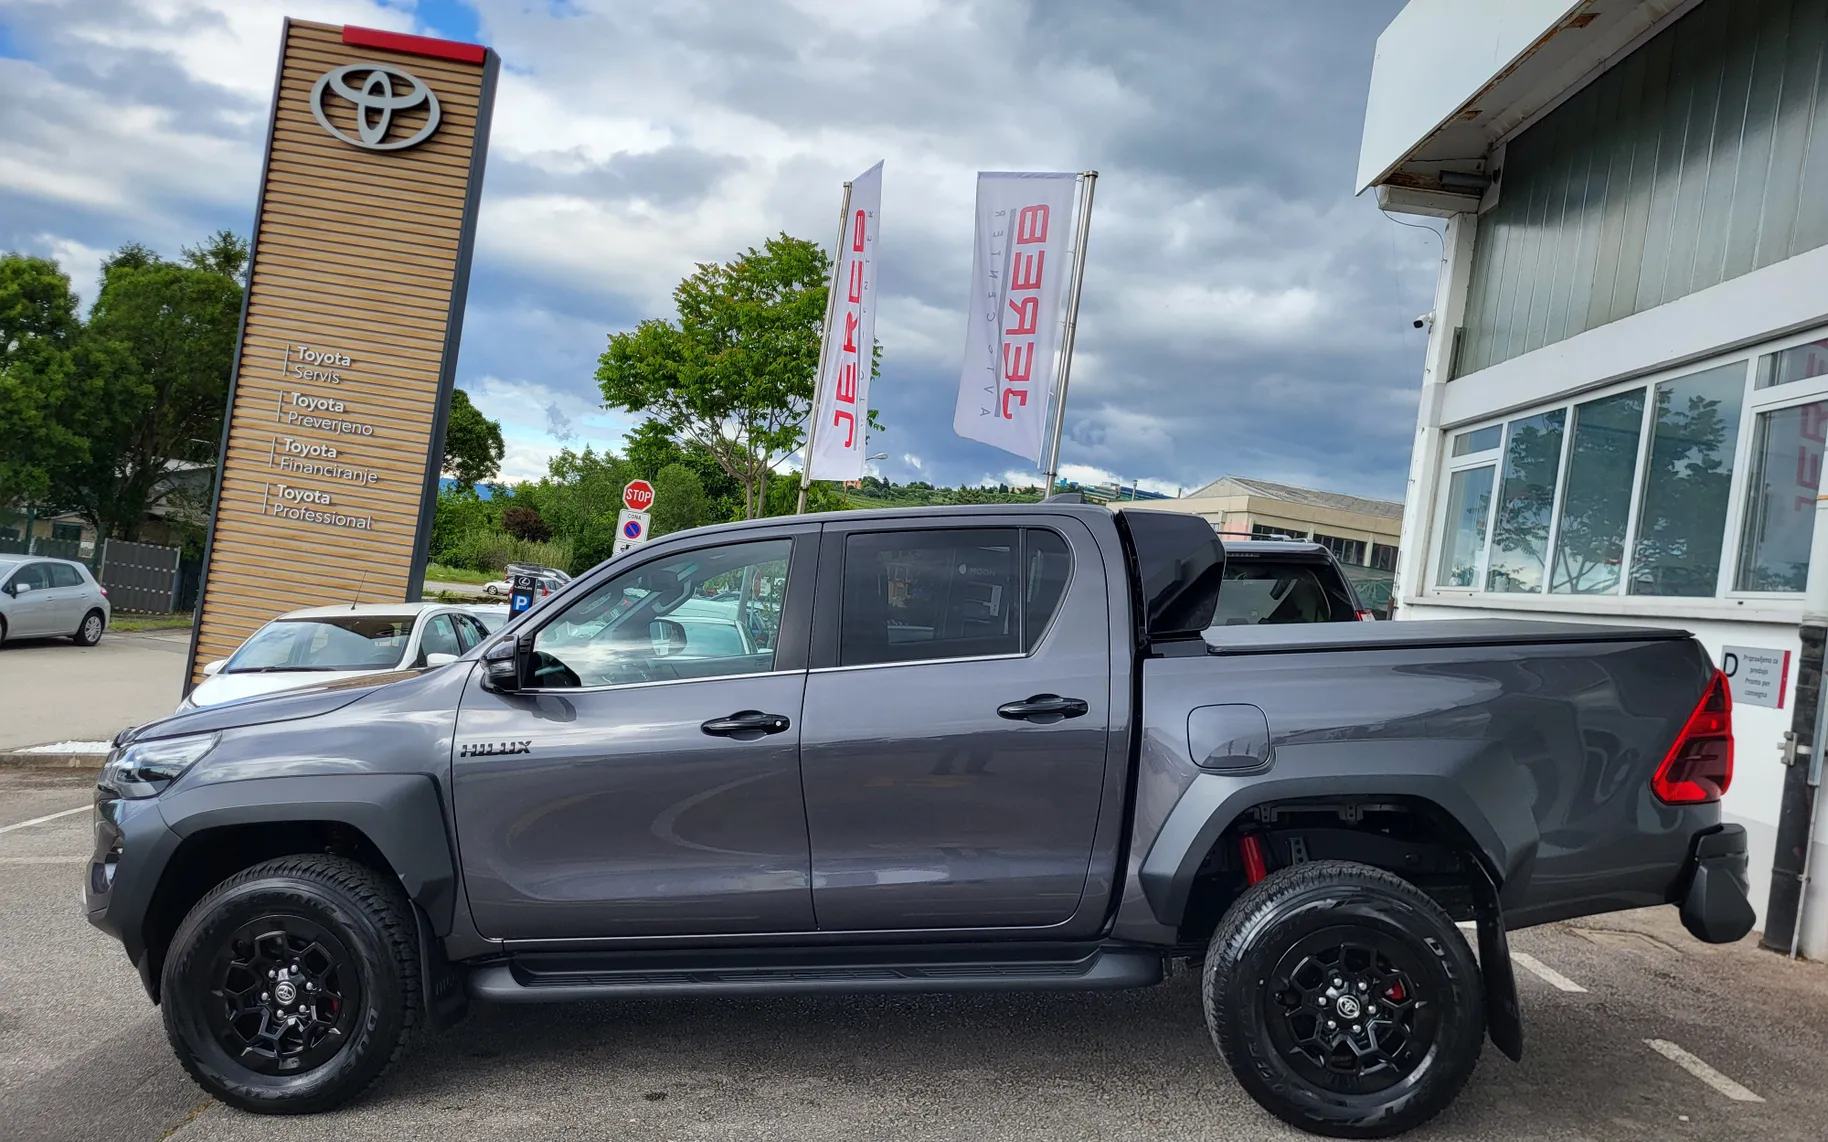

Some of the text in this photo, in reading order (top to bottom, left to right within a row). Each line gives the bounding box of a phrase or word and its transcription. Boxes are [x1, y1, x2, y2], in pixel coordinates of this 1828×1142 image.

[297, 346, 351, 367] Toyota
[293, 364, 340, 384] Servis
[291, 391, 345, 413] Toyota
[287, 411, 374, 436] Preverjeno
[283, 437, 338, 459] Toyota
[279, 456, 379, 486] Financiranje
[277, 484, 331, 505] Toyota
[626, 488, 652, 503] STOP
[272, 503, 373, 530] Professional
[627, 513, 642, 521] CONA
[515, 595, 528, 610] P
[460, 740, 533, 758] HILUX
